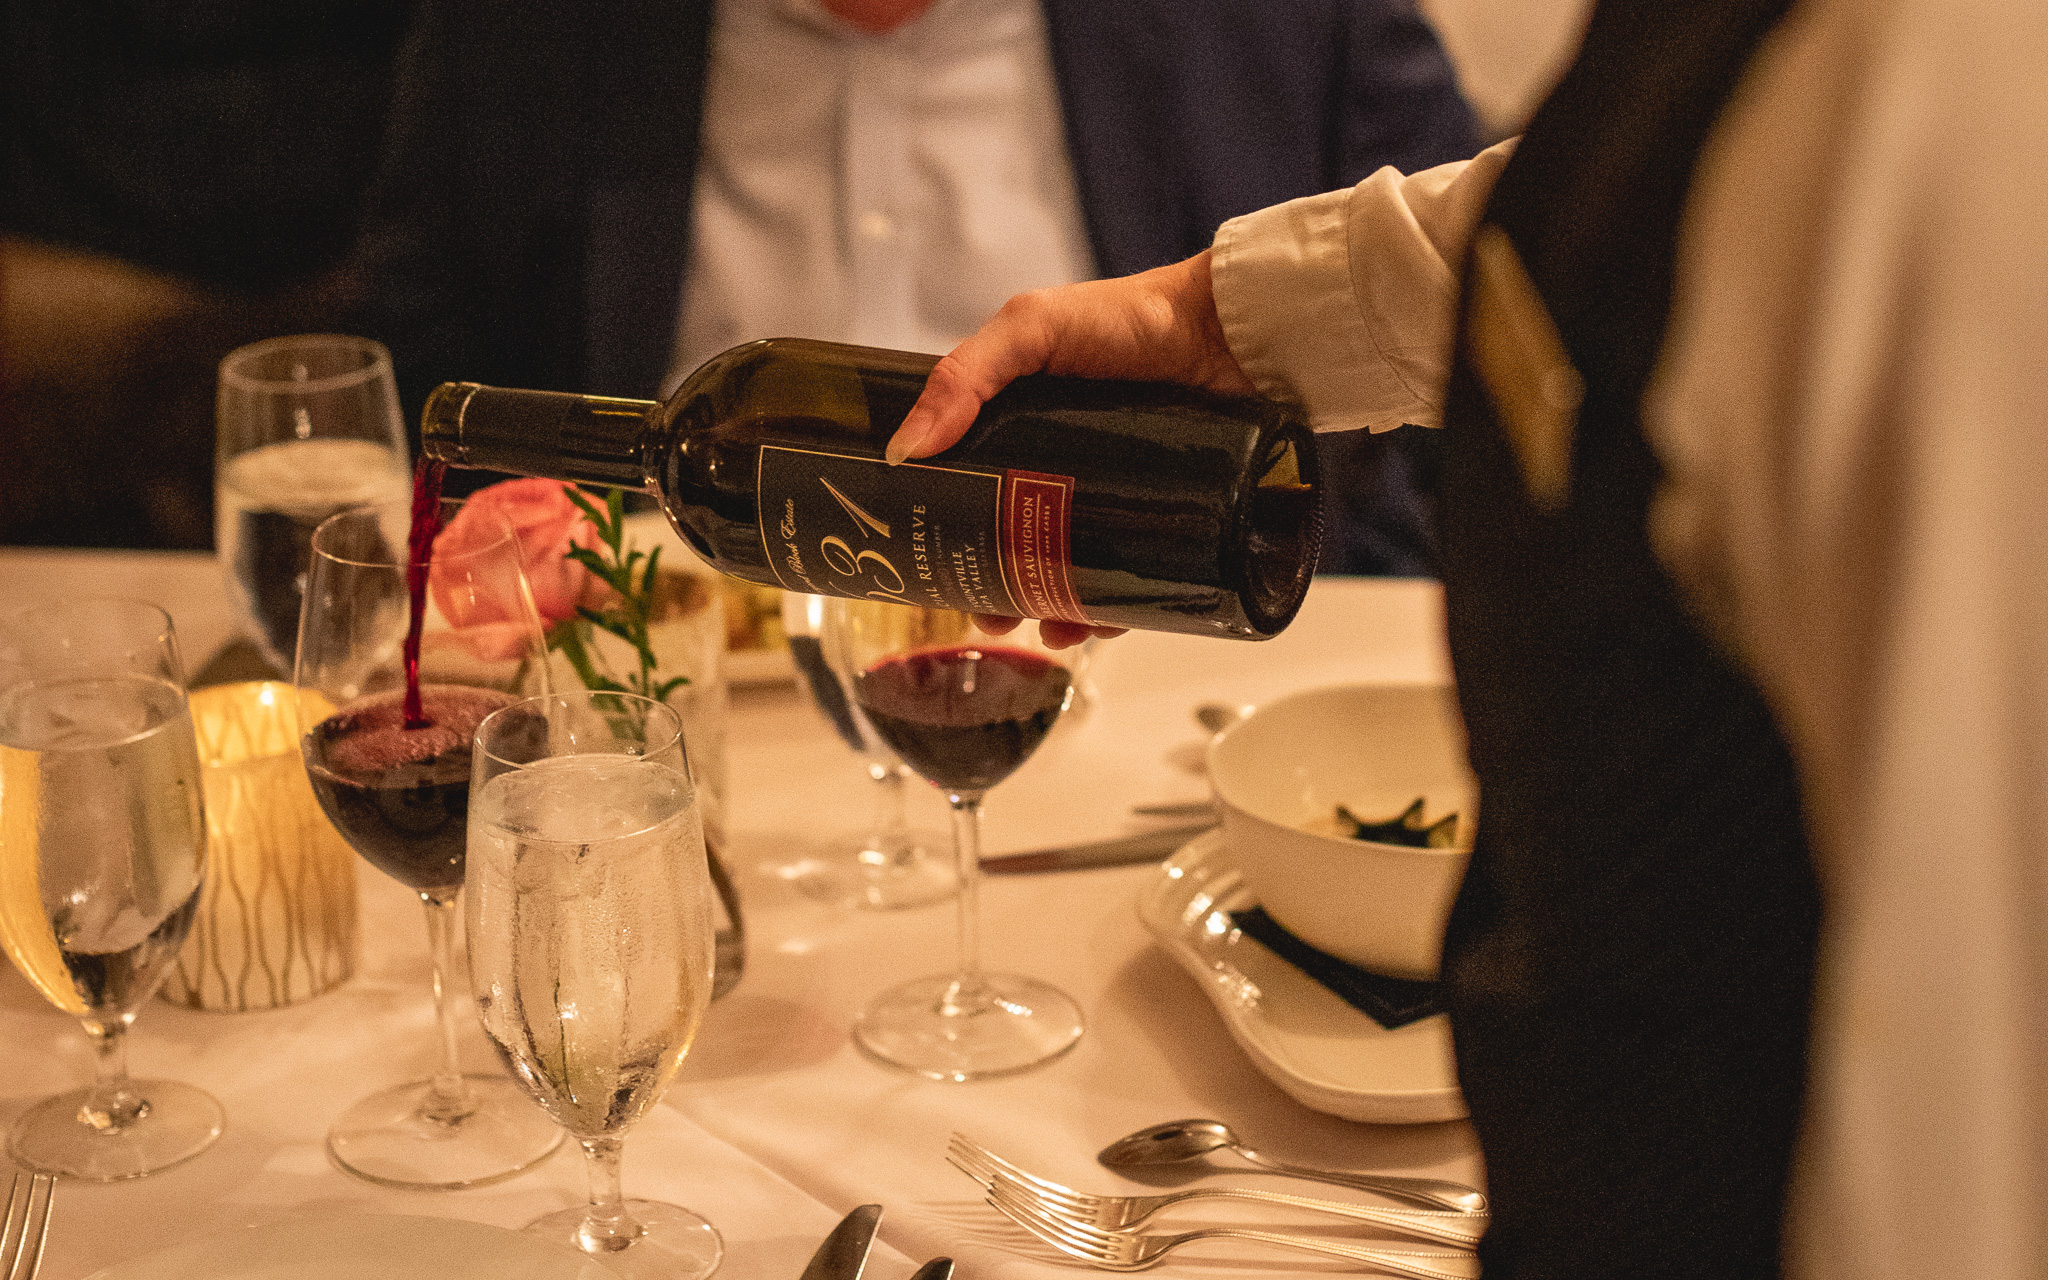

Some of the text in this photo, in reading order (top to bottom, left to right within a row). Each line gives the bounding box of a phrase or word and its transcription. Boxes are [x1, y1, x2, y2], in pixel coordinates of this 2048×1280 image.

[780, 498, 797, 540] Estate
[912, 504, 933, 581] RESERVE
[965, 543, 984, 590] VALLEY
[1021, 496, 1053, 618] BERNET SAUVIGNON
